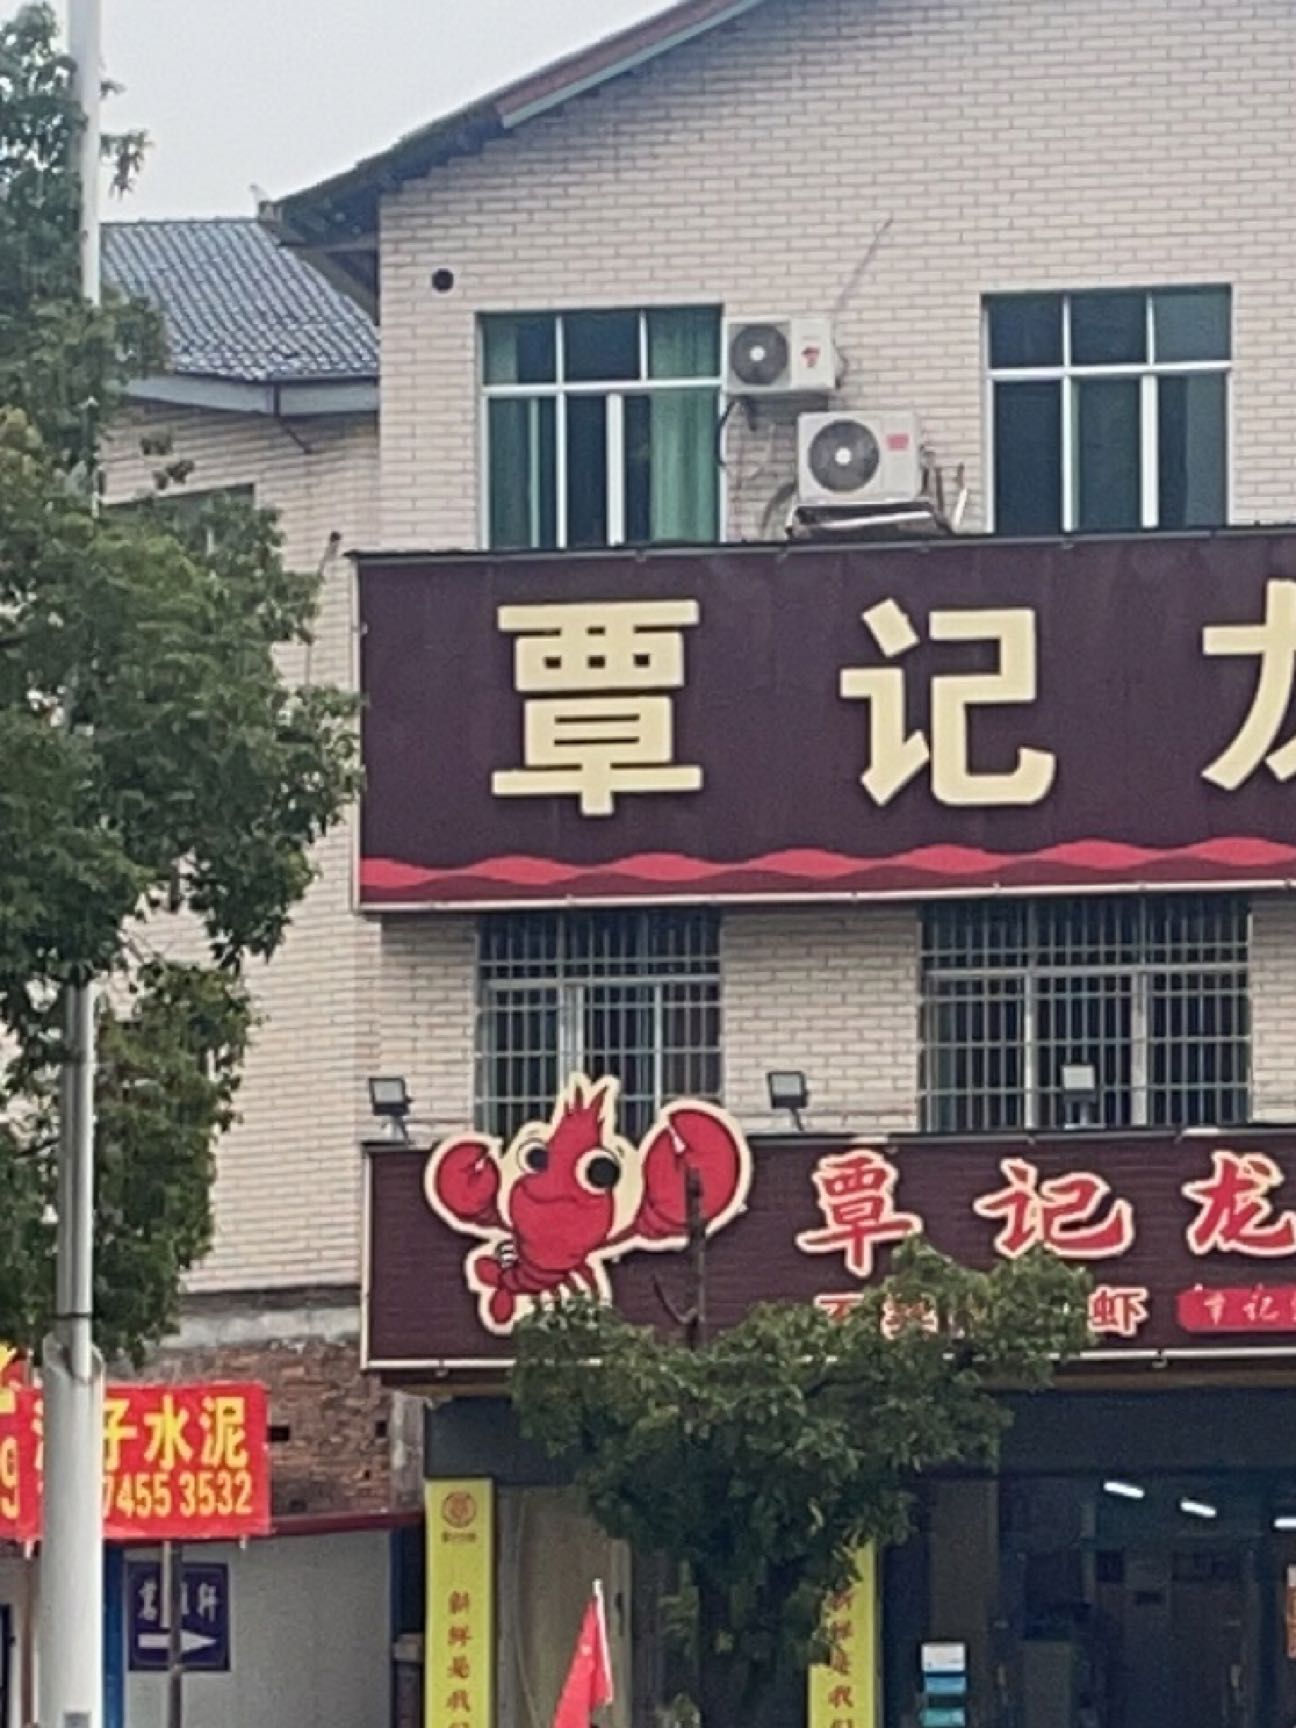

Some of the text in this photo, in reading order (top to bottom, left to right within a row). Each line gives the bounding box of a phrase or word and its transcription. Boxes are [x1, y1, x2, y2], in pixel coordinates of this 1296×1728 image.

[31, 1391, 249, 1471] 子水泥
[178, 1469, 254, 1517] 3532
